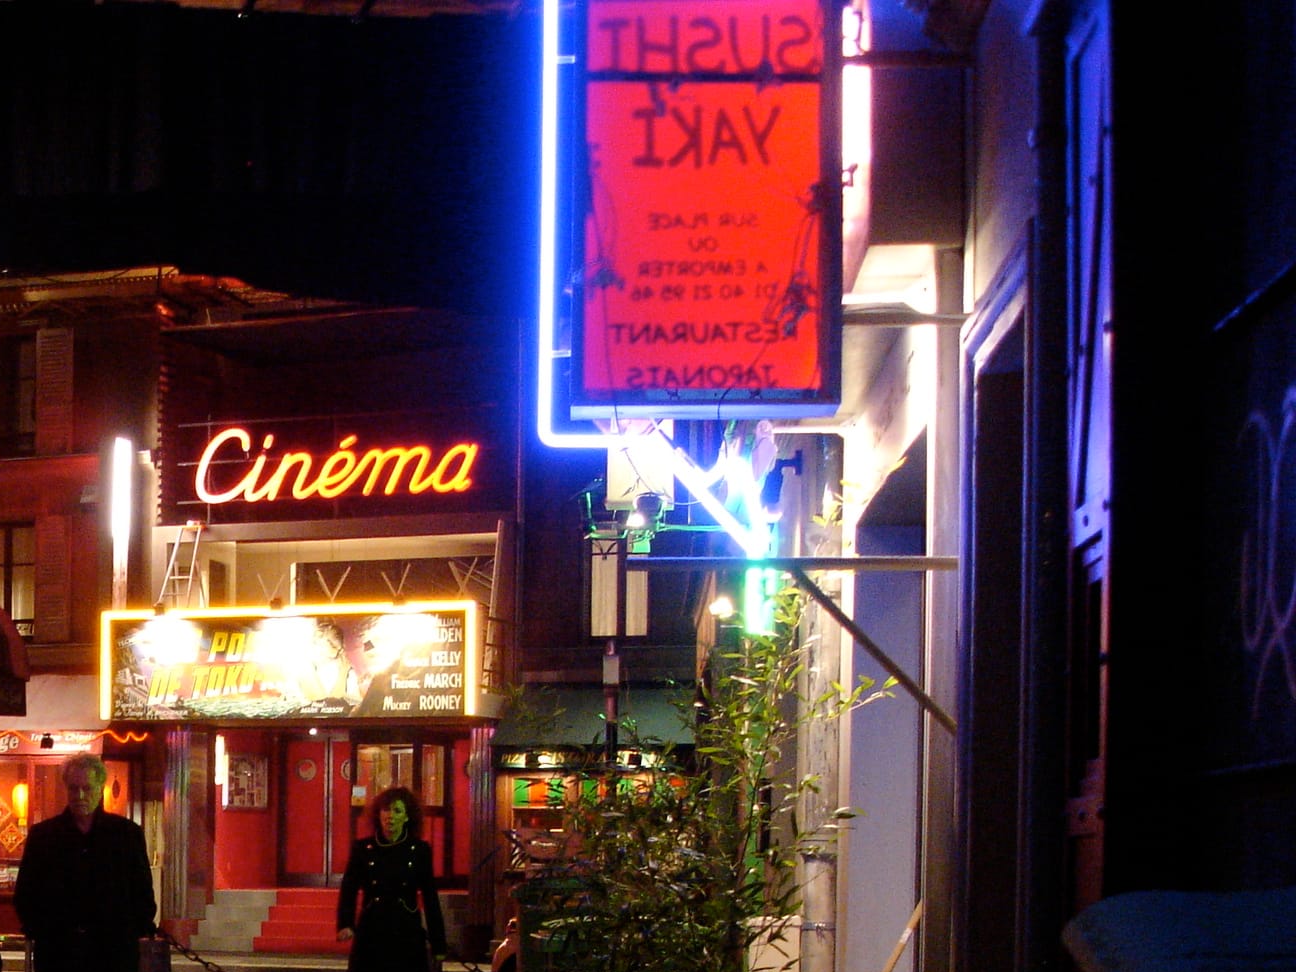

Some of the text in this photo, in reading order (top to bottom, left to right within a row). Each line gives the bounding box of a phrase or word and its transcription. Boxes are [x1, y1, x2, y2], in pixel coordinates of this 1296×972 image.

[195, 428, 479, 504] Cinéma
[431, 651, 461, 666] KELLY
[147, 667, 182, 704] DE
[424, 673, 463, 688] MARCH
[419, 695, 461, 711] ROONEY
